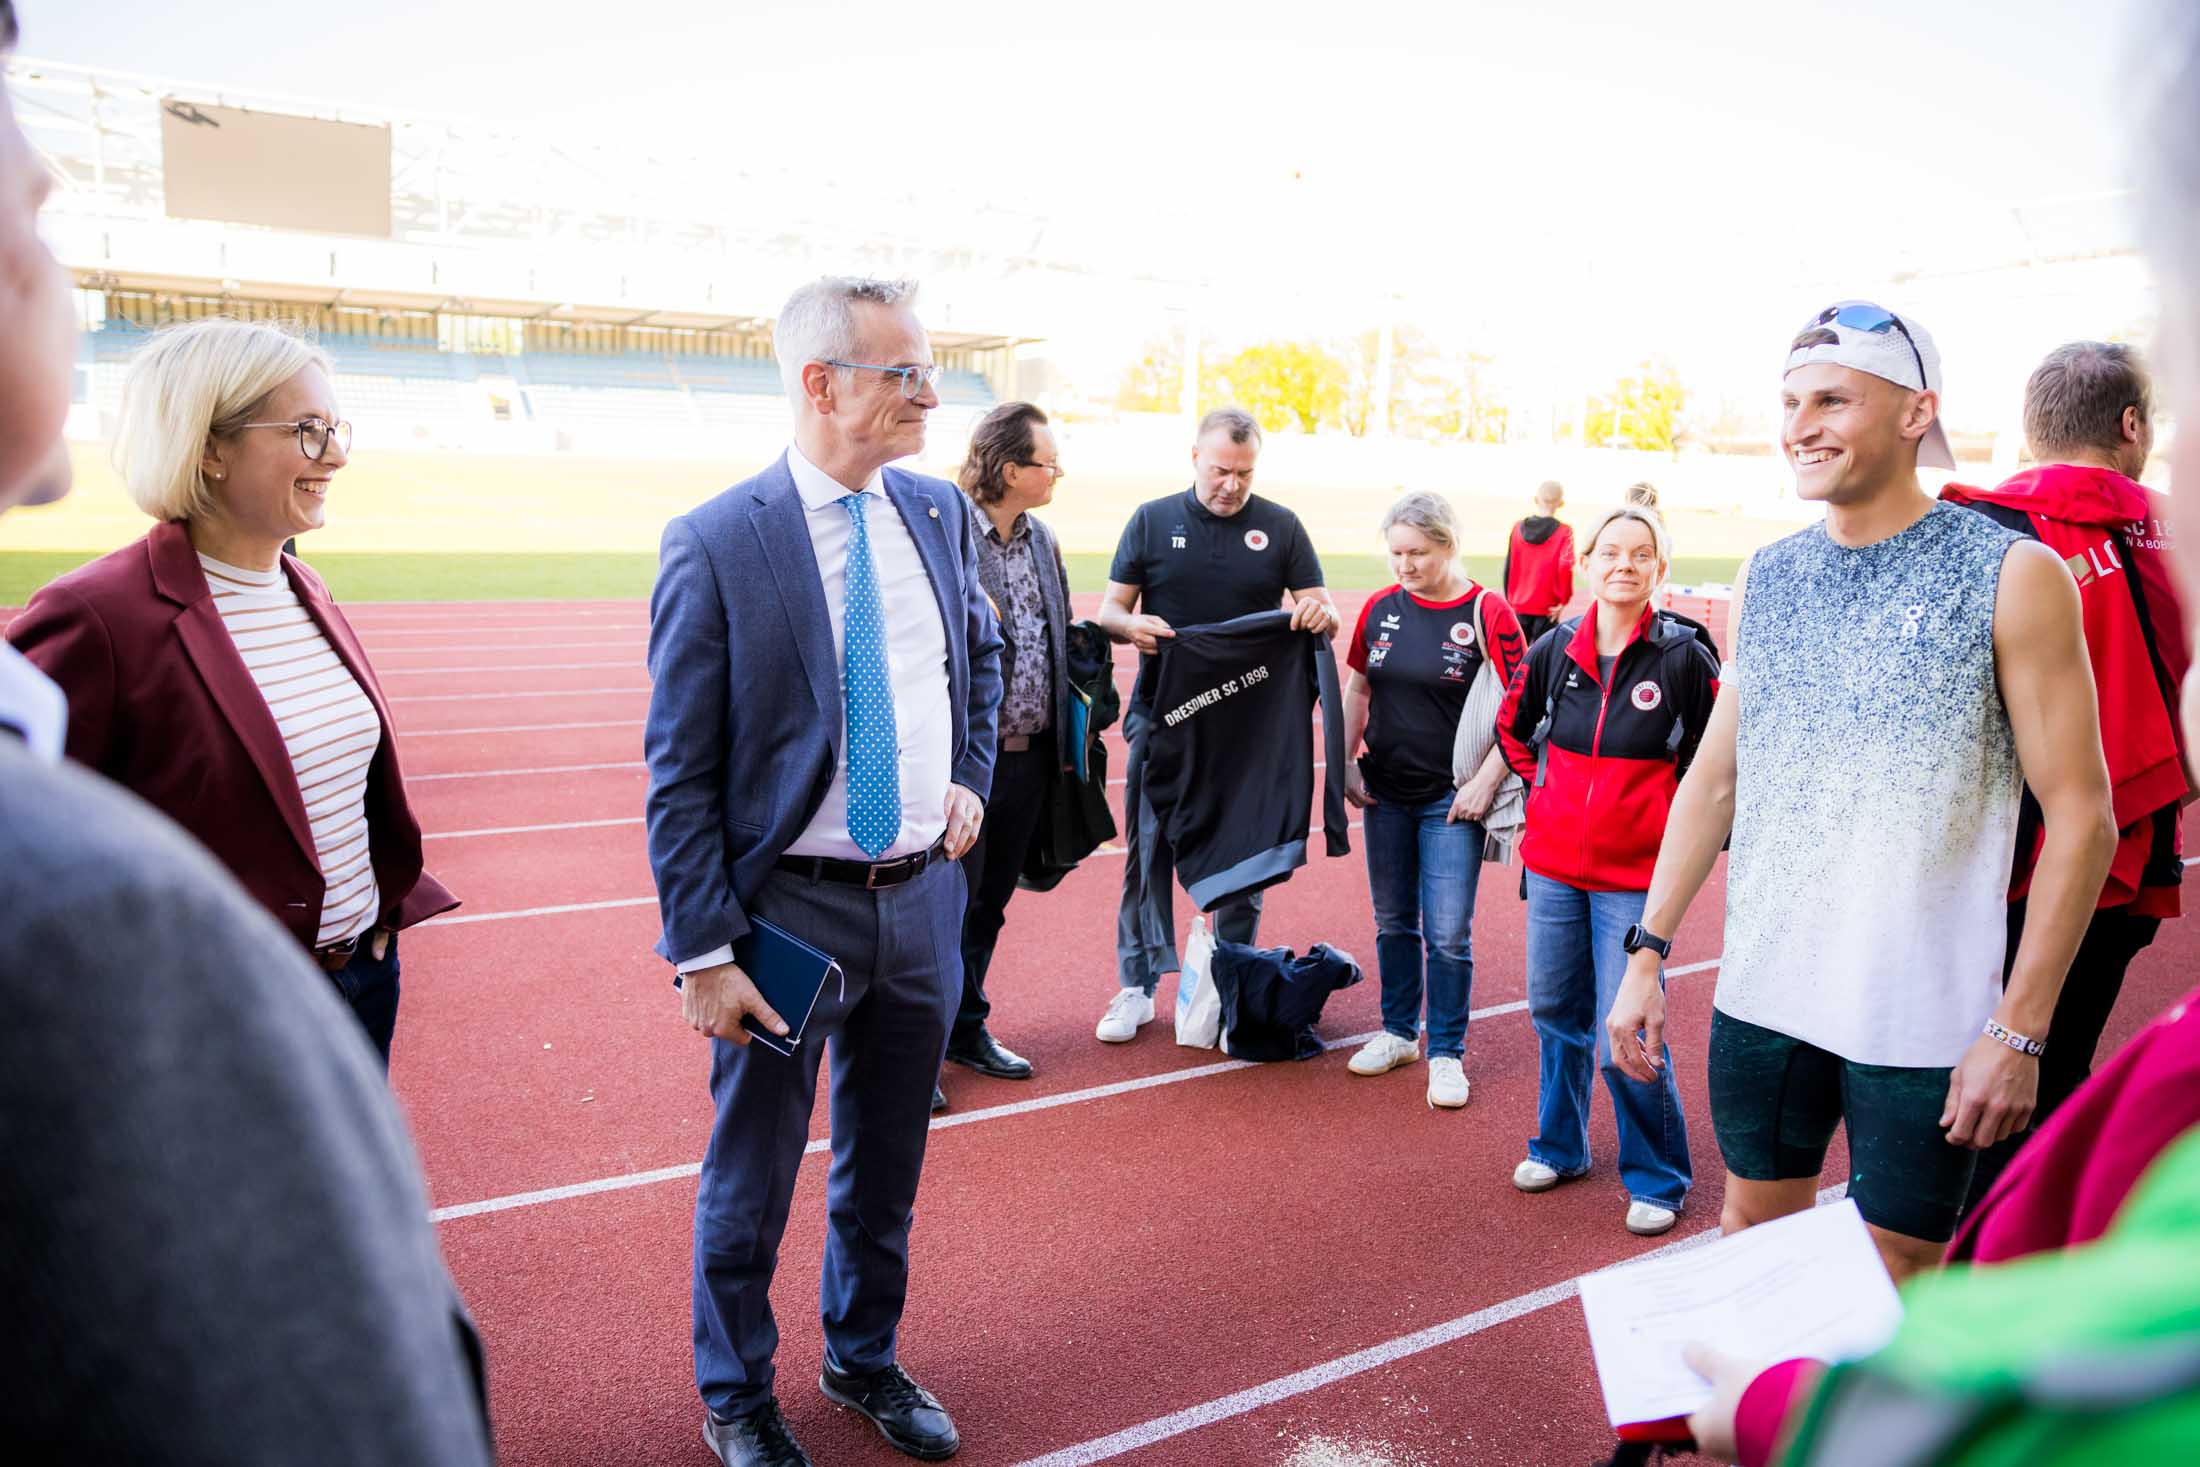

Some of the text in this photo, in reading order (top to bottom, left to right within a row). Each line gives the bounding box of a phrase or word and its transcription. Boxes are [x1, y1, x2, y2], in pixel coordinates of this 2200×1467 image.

[1171, 536, 1186, 549] TR
[1164, 665, 1269, 727] DRESDNER SC 1898
